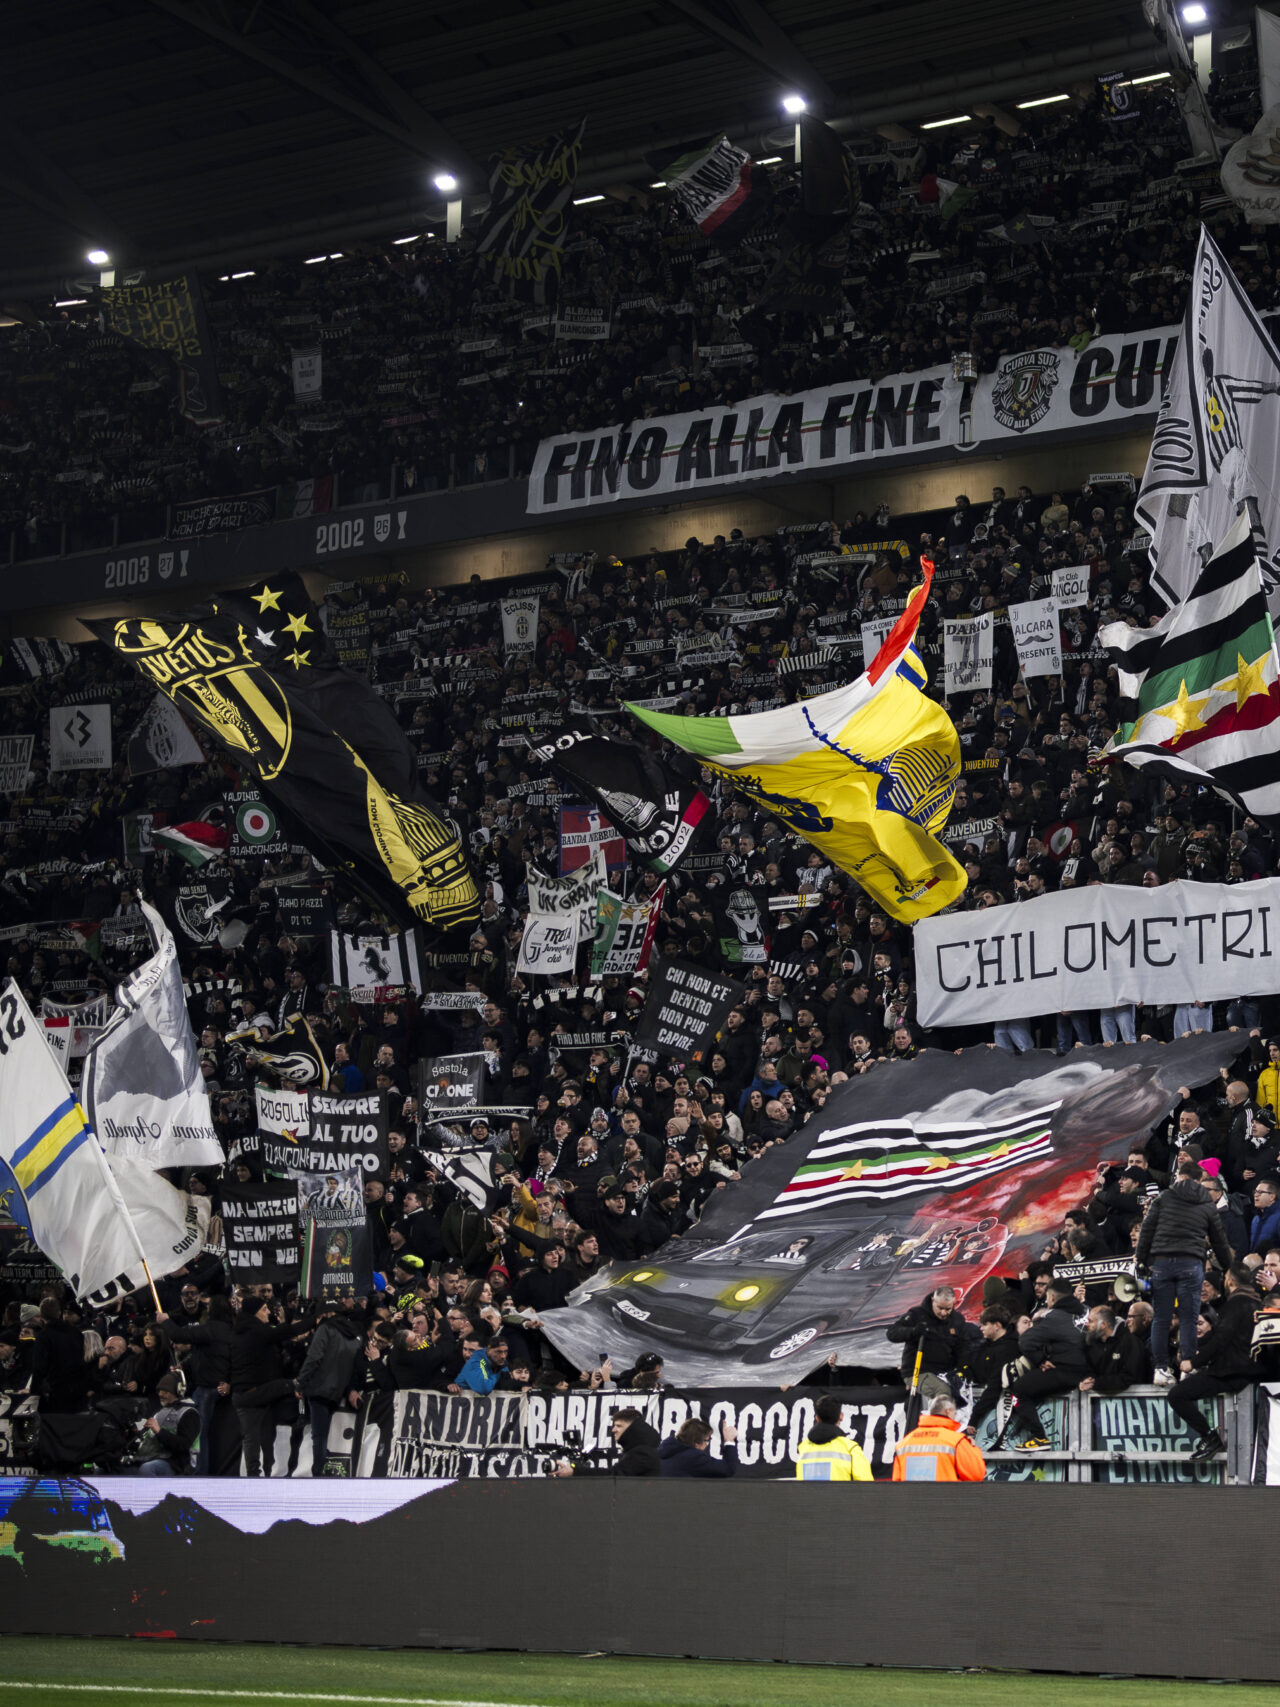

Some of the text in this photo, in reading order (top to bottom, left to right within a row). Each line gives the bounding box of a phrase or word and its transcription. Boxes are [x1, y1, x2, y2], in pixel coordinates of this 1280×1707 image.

[565, 306, 603, 317] ALBANO
[559, 324, 607, 336] BIANCONERA
[1004, 354, 1055, 373] CURVA SUD
[994, 403, 1050, 428] FINO ALLA FINE
[541, 378, 942, 505] FINO ALLA FINE
[315, 517, 390, 554] 2002 26
[105, 555, 172, 589] 2003 27
[751, 588, 783, 600] JUVENTUS
[503, 599, 536, 615] ECLISSE
[819, 611, 848, 627] JUVENTUS
[861, 623, 878, 634] UNICA
[945, 618, 990, 637] DARIO
[1014, 618, 1054, 636] ALCARA
[635, 639, 664, 652] JUVENTUS
[1018, 646, 1057, 661] PRESENTE
[805, 682, 839, 696] JUVENTUS
[501, 712, 535, 725] JUVENTUS
[965, 758, 1000, 771] JUVENTUS
[507, 778, 550, 797] JUVENTUS
[370, 796, 379, 818] MOLE
[526, 794, 543, 806] OUR
[948, 818, 995, 836] JUVENTUS
[371, 818, 394, 865] MANIPOLO
[561, 833, 588, 846] BANDA
[664, 825, 690, 862] 2002
[229, 842, 289, 857] BIANCONERA
[278, 896, 324, 909] SIAMO PAZZI
[537, 891, 557, 913] UN
[290, 914, 312, 926] DI TE
[612, 923, 648, 951] 38
[438, 952, 468, 965] JUVENTUS
[936, 905, 1273, 993] CHILOMETRI
[546, 953, 563, 965] club
[51, 979, 89, 991] JUVENTUS
[665, 965, 686, 987] CHI
[686, 972, 711, 996] NON
[669, 989, 713, 1018] DENTRO
[657, 1005, 684, 1028] NON
[47, 1032, 67, 1051] FINE
[556, 1031, 606, 1045] FINO ALLA FINE
[657, 1027, 696, 1051] CAPIRE
[431, 1063, 469, 1077] Sestola
[311, 1095, 381, 1115] SEMPRE
[312, 1125, 378, 1144] AL TUO
[310, 1152, 380, 1172] FIANCO
[222, 1196, 297, 1219] MAURIZIO
[173, 1204, 199, 1257] CURVA SUD
[233, 1223, 295, 1243] SEMPRE
[228, 1247, 299, 1267] CON NOI
[1054, 1259, 1131, 1278] FORZA JUVE
[322, 1272, 354, 1285] BOTRICELLO
[402, 1391, 522, 1448] ANDRIA
